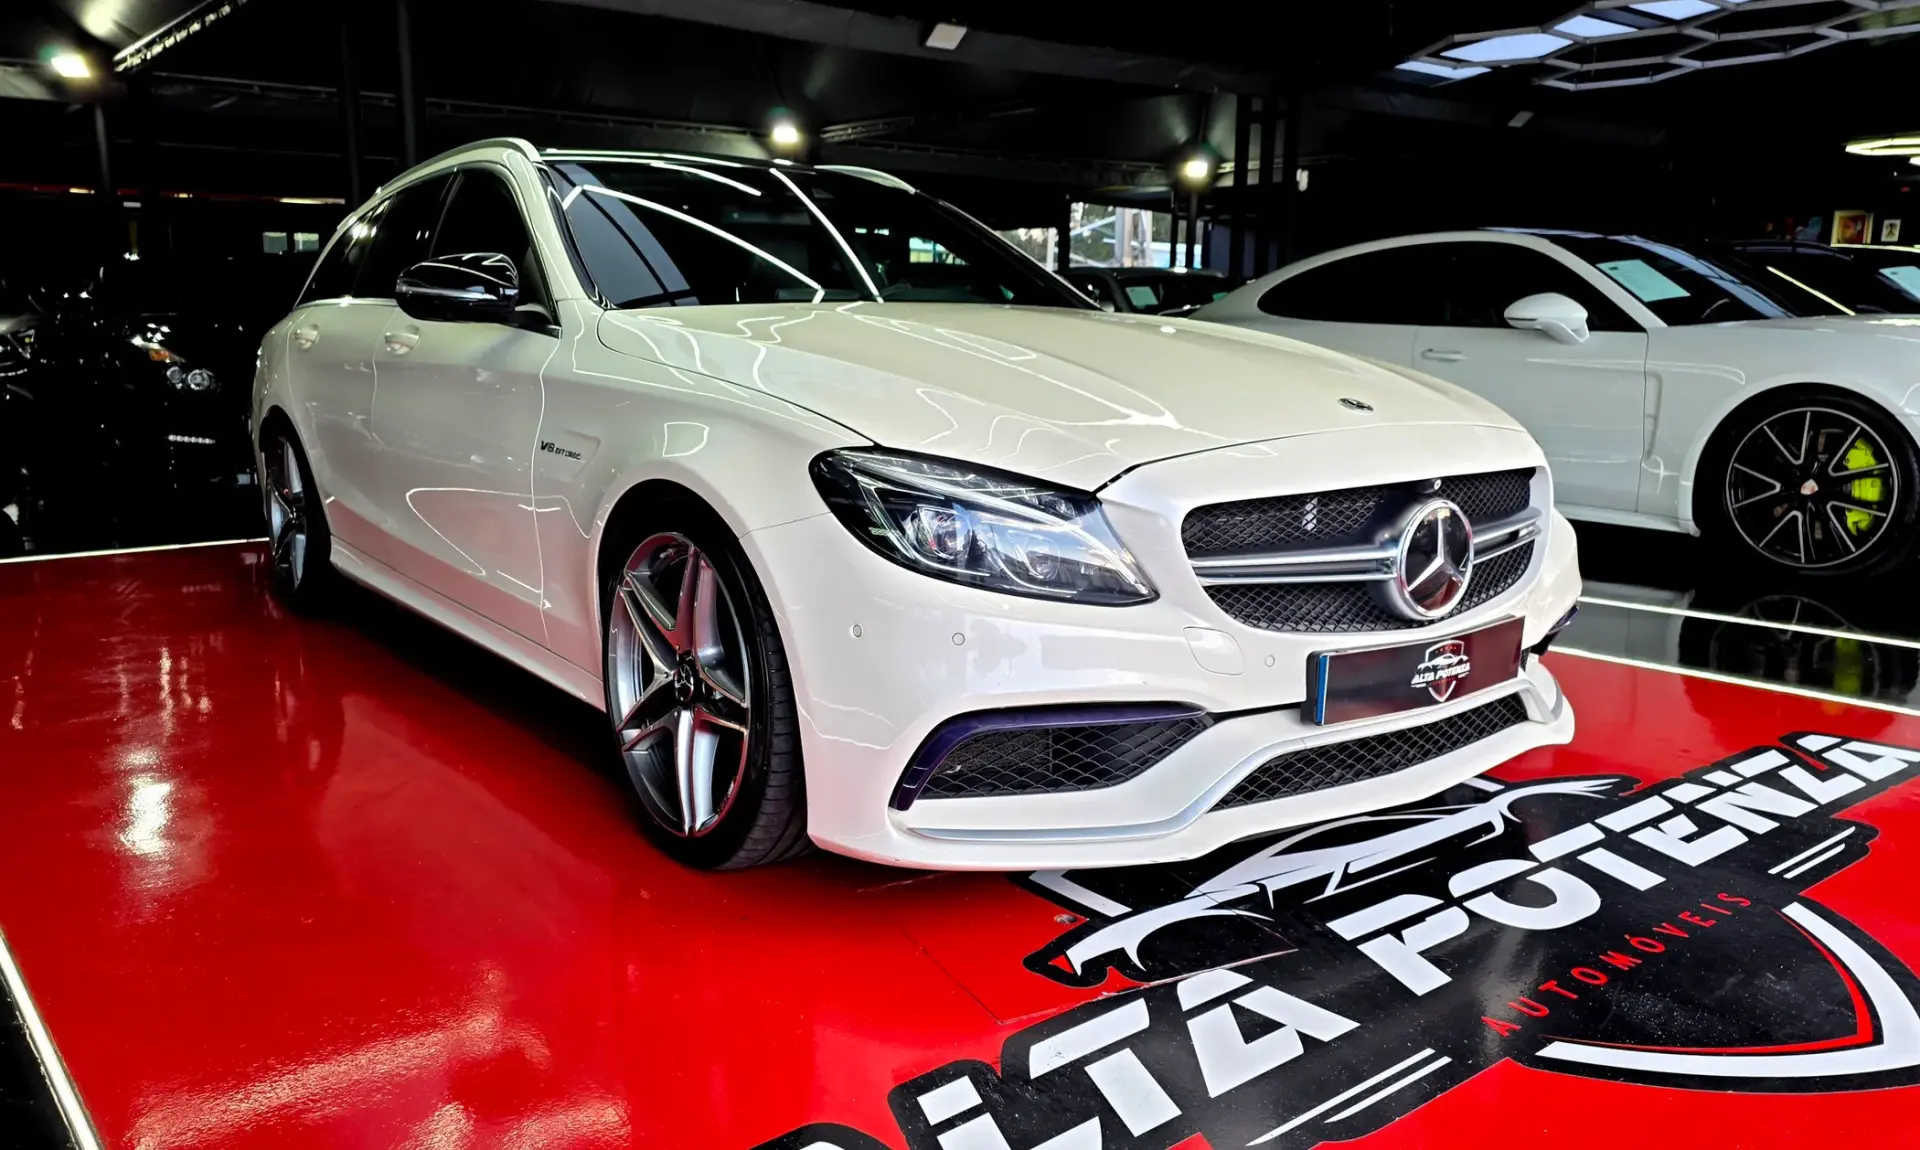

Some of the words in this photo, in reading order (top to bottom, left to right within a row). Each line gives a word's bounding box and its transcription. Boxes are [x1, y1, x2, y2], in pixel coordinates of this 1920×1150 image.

[540, 440, 555, 453] V8
[1411, 671, 1435, 685] ALTA
[1435, 662, 1470, 680] POTENZA
[799, 968, 1361, 1150] LTA
[1325, 734, 1920, 997] POTENZA
[1481, 892, 1751, 1038] AUTOMÓVEIS
